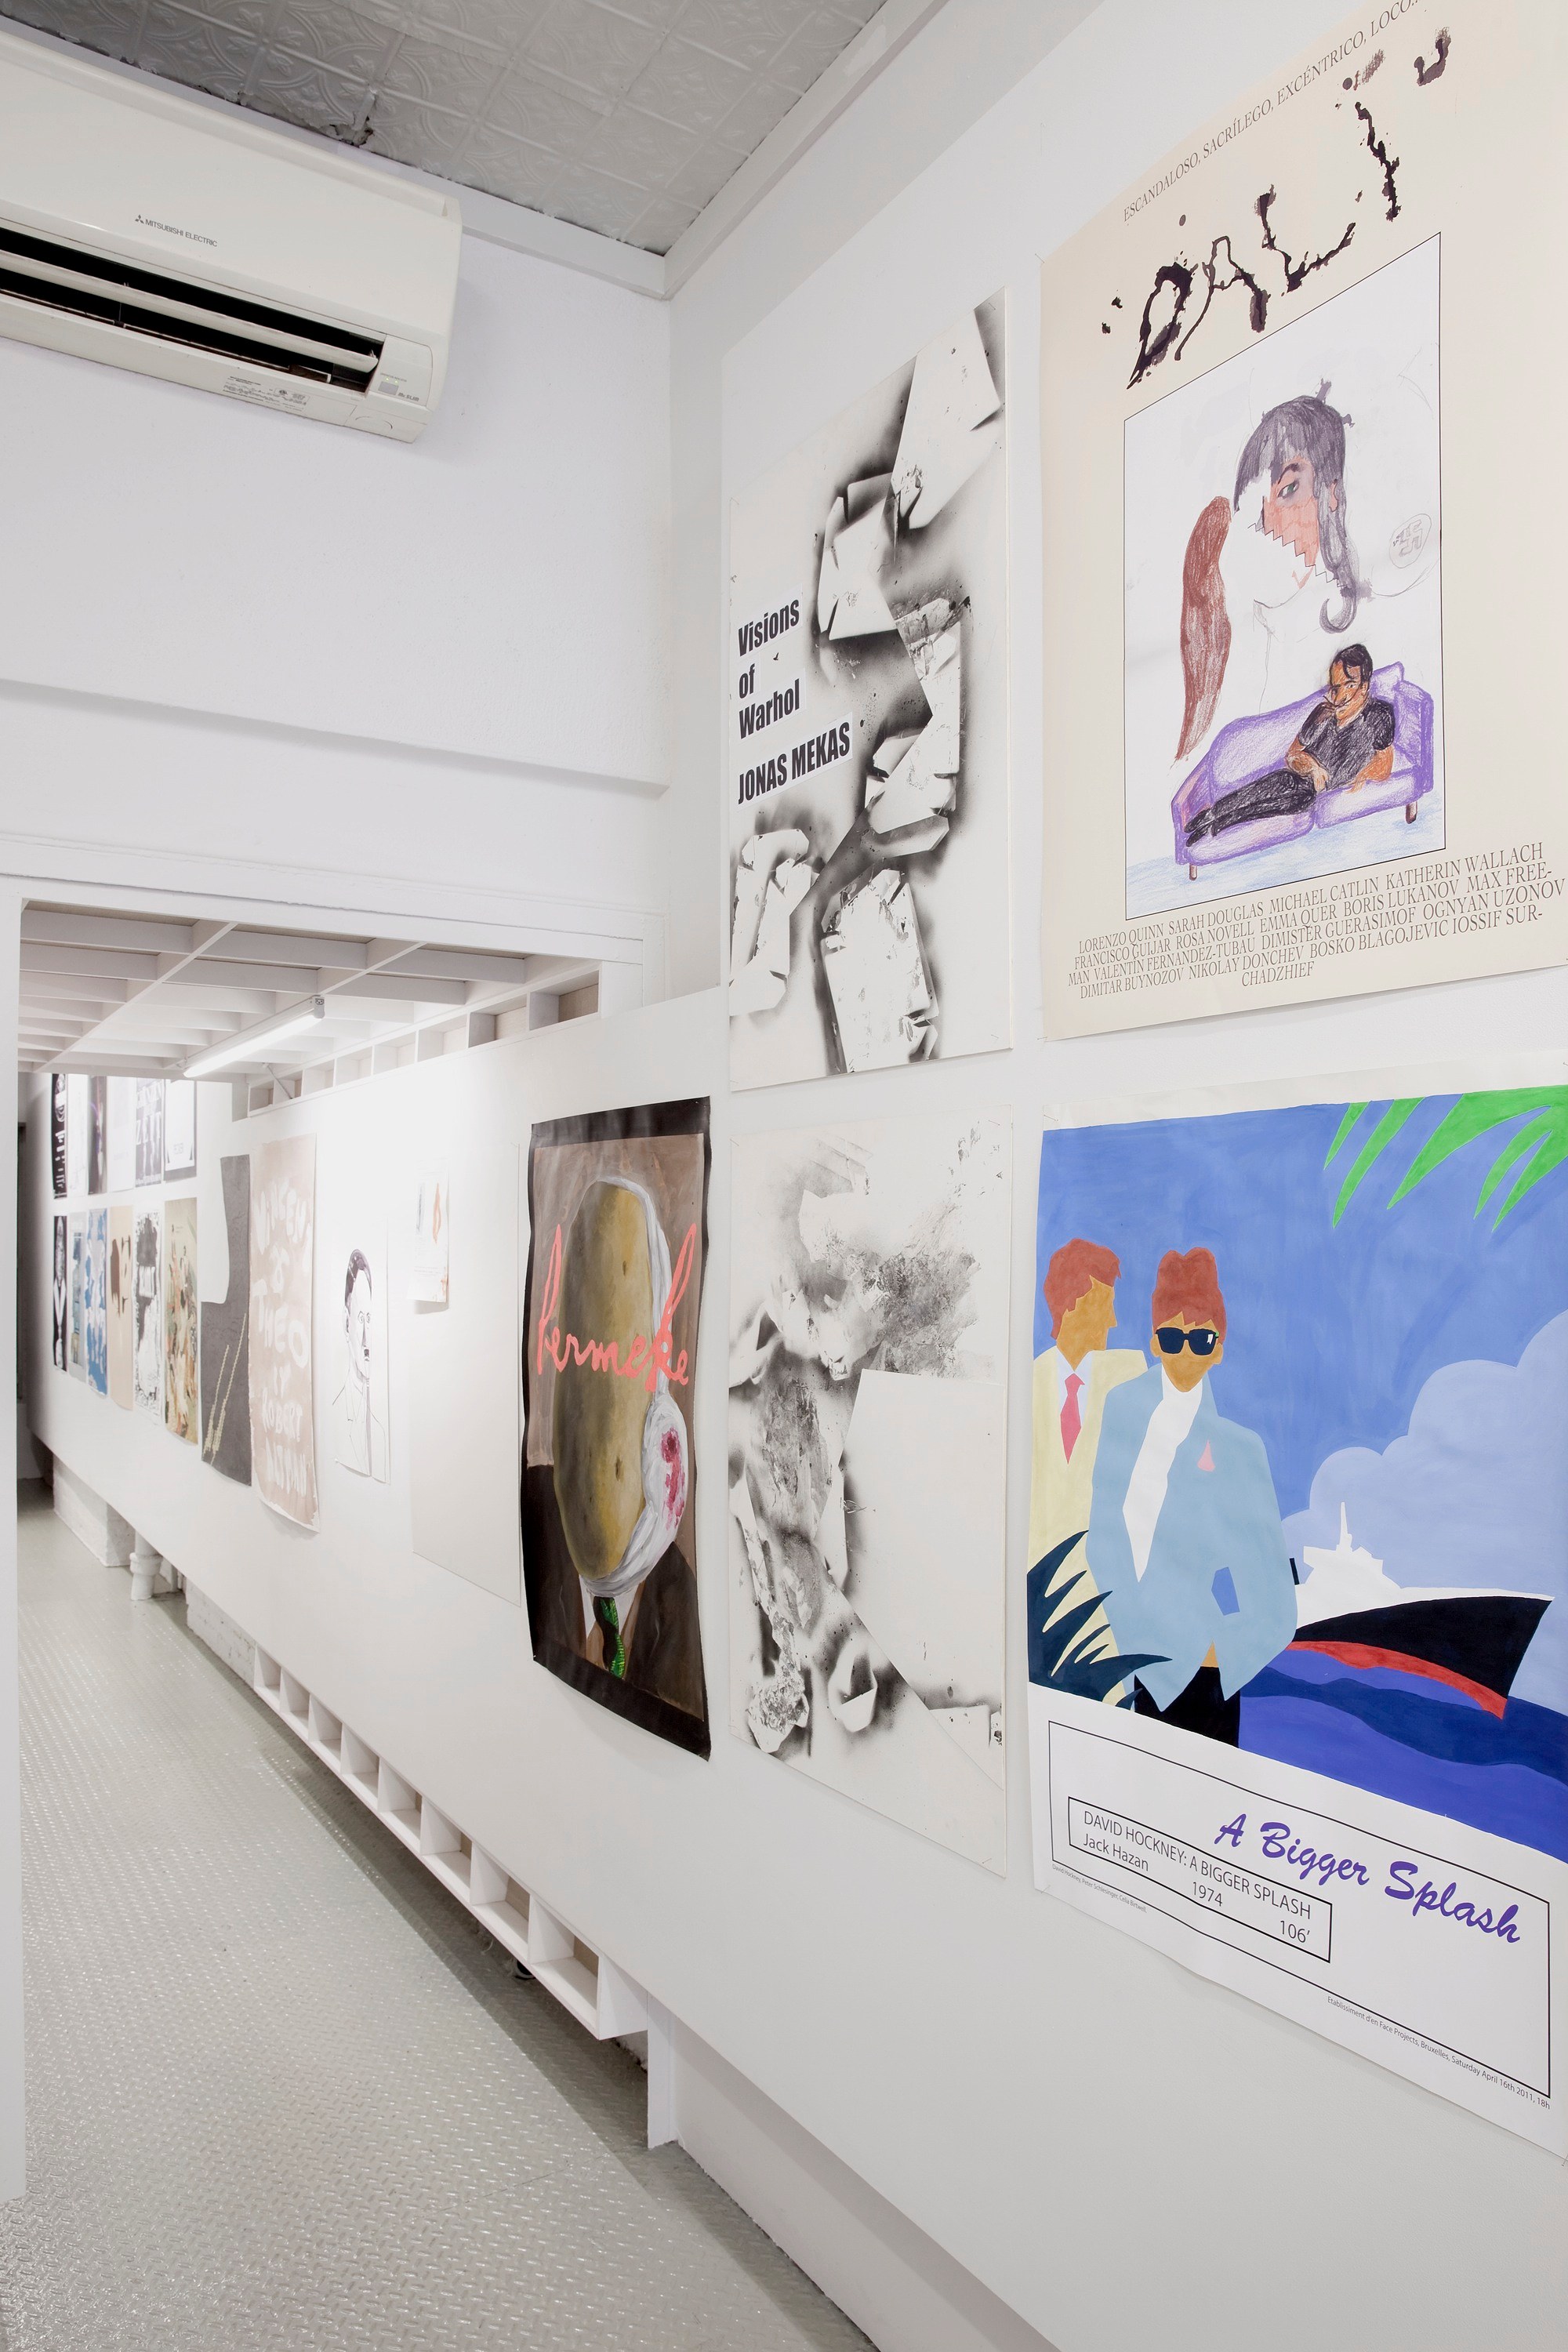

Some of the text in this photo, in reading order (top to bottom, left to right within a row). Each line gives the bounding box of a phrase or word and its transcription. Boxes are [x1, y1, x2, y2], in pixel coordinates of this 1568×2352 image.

[1123, 151, 1201, 223] ESCANDALOSO,
[1203, 99, 1274, 159] SACRÍLEGO,
[1277, 31, 1367, 106] EXCÉNTRICO,
[145, 219, 218, 247] MITSUBISHI ELECTRIC
[738, 599, 800, 656] Visions
[739, 663, 755, 699] of
[739, 678, 800, 739] Warhol
[738, 721, 850, 804] JONAS MEKAS
[1068, 970, 1091, 986] MAN
[1261, 925, 1322, 950] DIMISTER
[1326, 906, 1416, 938] GUERASIMOF
[1423, 894, 1489, 920] OGNYAN
[1493, 878, 1565, 907] UZONOV
[1074, 946, 1131, 970] FRANCISCO
[1176, 930, 1204, 949] ROSA
[1207, 920, 1254, 944] NOVELL
[1260, 912, 1297, 933] EMMA
[1301, 904, 1337, 928] QUER
[1344, 895, 1385, 917] BORIS
[1388, 879, 1459, 906] LUKANOV
[1467, 871, 1501, 894] MAX
[1506, 862, 1552, 885] FREE-
[1079, 842, 1544, 953] LORENZO QUINN SARAH DOUGLAS MICHAEL CATLIN KATHERIN WALLACH
[1080, 904, 1543, 999] DIMITAR BUYNOZOV NIKOLAY DONCHEV BOSKO BLAGOJEVIC IOSSIF SUR-
[1242, 961, 1315, 987] CHADZHIEF
[251, 1279, 310, 1369] THEO
[262, 1387, 303, 1442] ROBERT
[1052, 1864, 1064, 1874] David
[1082, 1878, 1093, 1888] Peter
[1083, 1833, 1149, 1871] Jack Hazan
[1084, 1810, 1310, 1920] DAVID HOCKNEY: A BIGGER SPLASH
[1214, 1814, 1521, 1944] A Bigger Splash
[1192, 1882, 1223, 1907] 1974
[1327, 1996, 1365, 2020] Etablissiment
[1380, 2021, 1393, 2033] Face
[1394, 2027, 1420, 2046] Projects,
[1421, 2041, 1450, 2062] Bruxelles,
[1452, 2056, 1481, 2076] Saturday
[1482, 2071, 1498, 2084] April
[1500, 2078, 1515, 2092] 16th
[1516, 2087, 1535, 2103] 2011,
[1537, 2097, 1551, 2110] 18h
